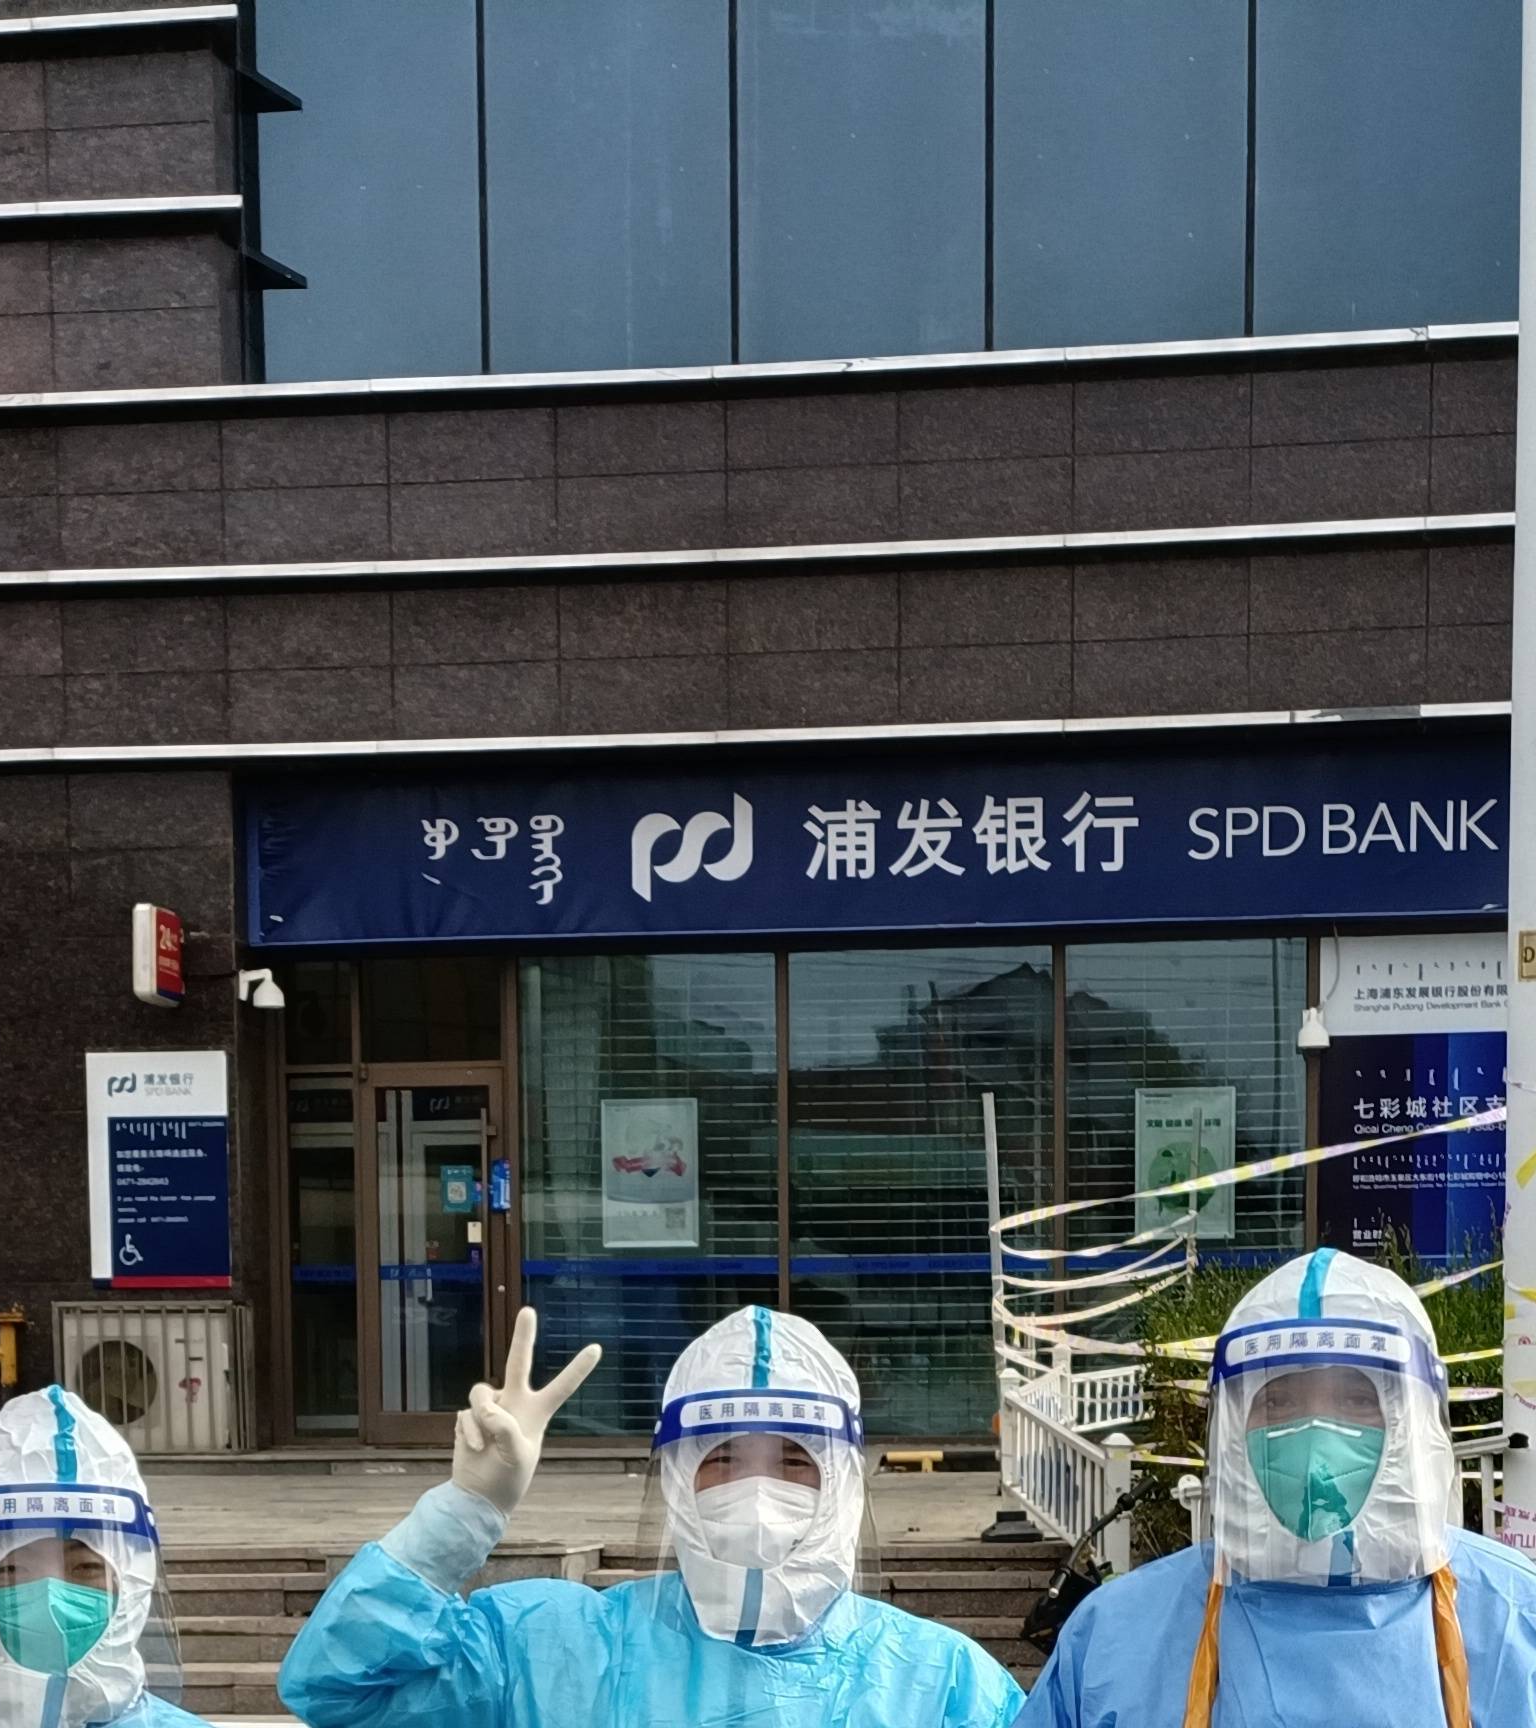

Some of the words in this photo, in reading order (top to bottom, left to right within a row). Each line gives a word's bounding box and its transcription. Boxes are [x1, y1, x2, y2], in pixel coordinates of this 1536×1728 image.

[802, 791, 1140, 881] 浦发银行
[1187, 805, 1307, 861] SPD
[1321, 798, 1499, 855] BANK
[1393, 1002, 1424, 1012] Pudong
[1426, 1001, 1478, 1011] Development
[1480, 1000, 1501, 1009] Bank
[1244, 1331, 1387, 1356] 医用隔离面罩
[698, 1401, 827, 1421] 医用隔离面罩
